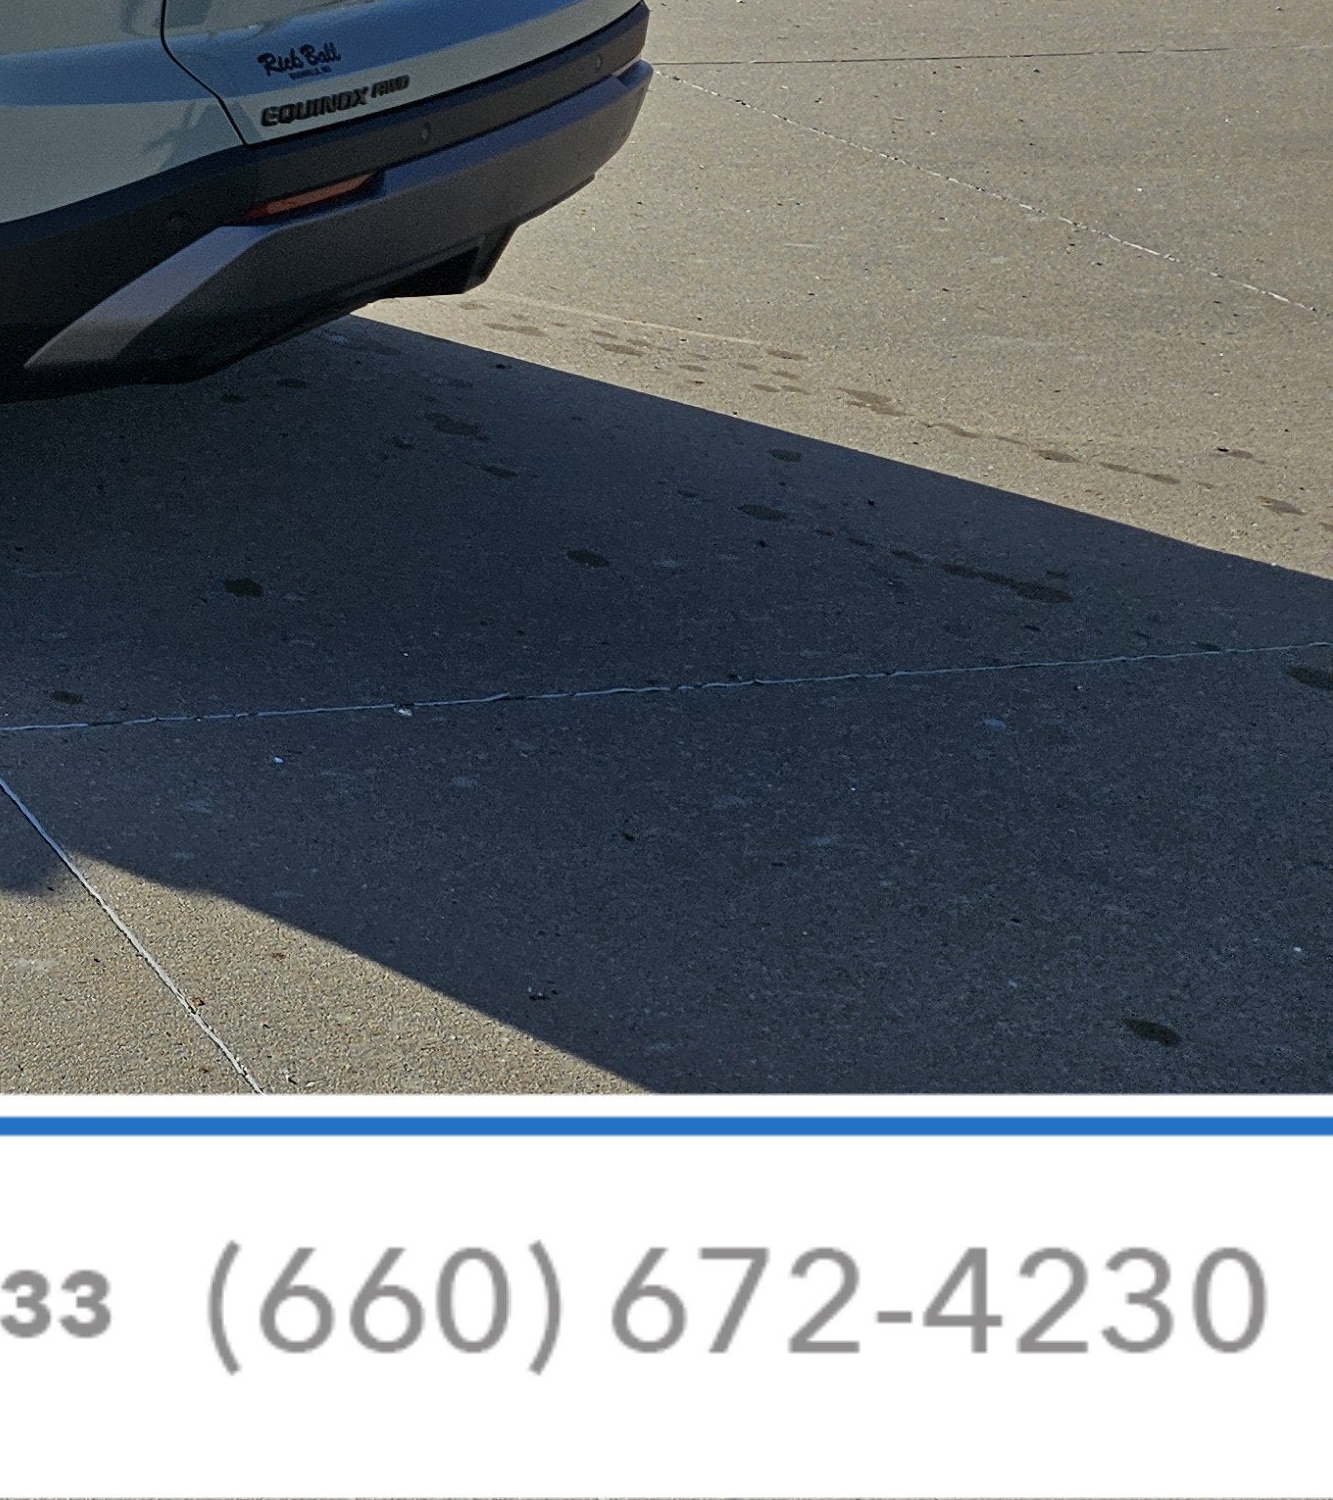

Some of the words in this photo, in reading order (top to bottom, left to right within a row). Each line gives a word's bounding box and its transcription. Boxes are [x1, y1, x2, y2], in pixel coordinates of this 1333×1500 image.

[257, 47, 304, 76] Rick
[300, 42, 341, 65] Ball
[260, 86, 369, 127] EQUINOX
